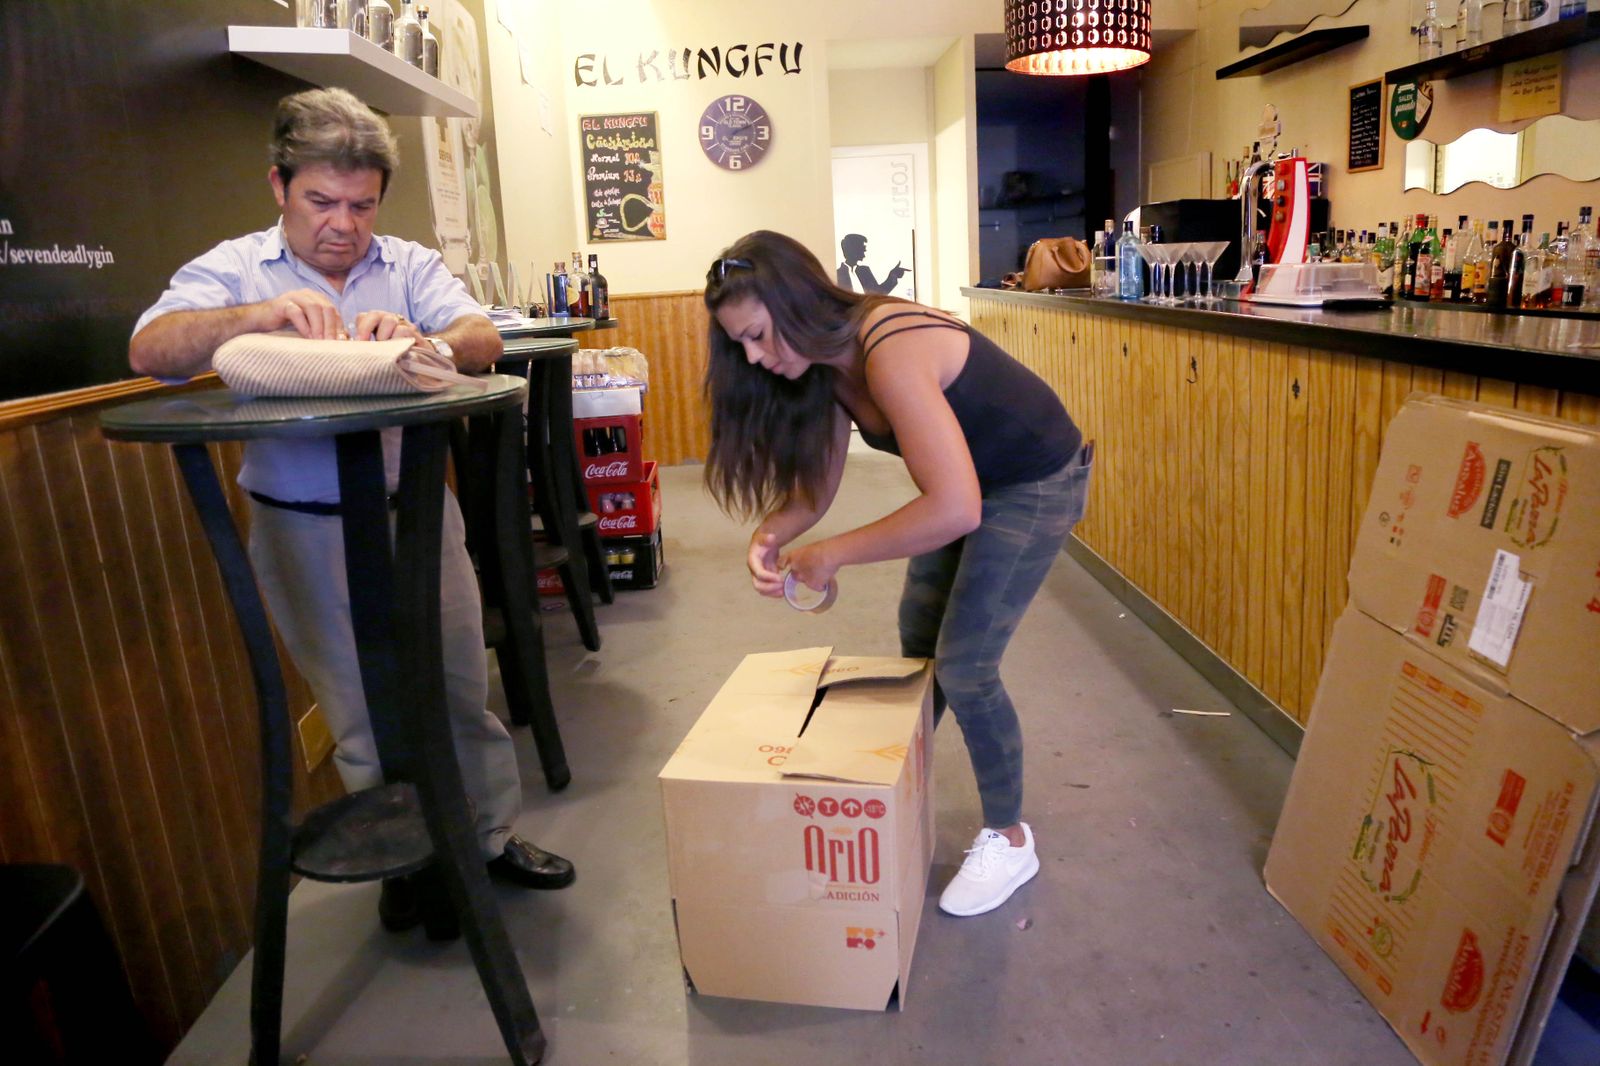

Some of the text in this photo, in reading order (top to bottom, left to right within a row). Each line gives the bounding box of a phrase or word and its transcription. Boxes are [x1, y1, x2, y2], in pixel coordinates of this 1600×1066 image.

[575, 43, 803, 87] EL KUNGFU
[724, 97, 745, 112] 12
[582, 119, 600, 131] EL
[701, 125, 714, 140] 9
[757, 125, 769, 140] 3
[729, 155, 742, 169] 6
